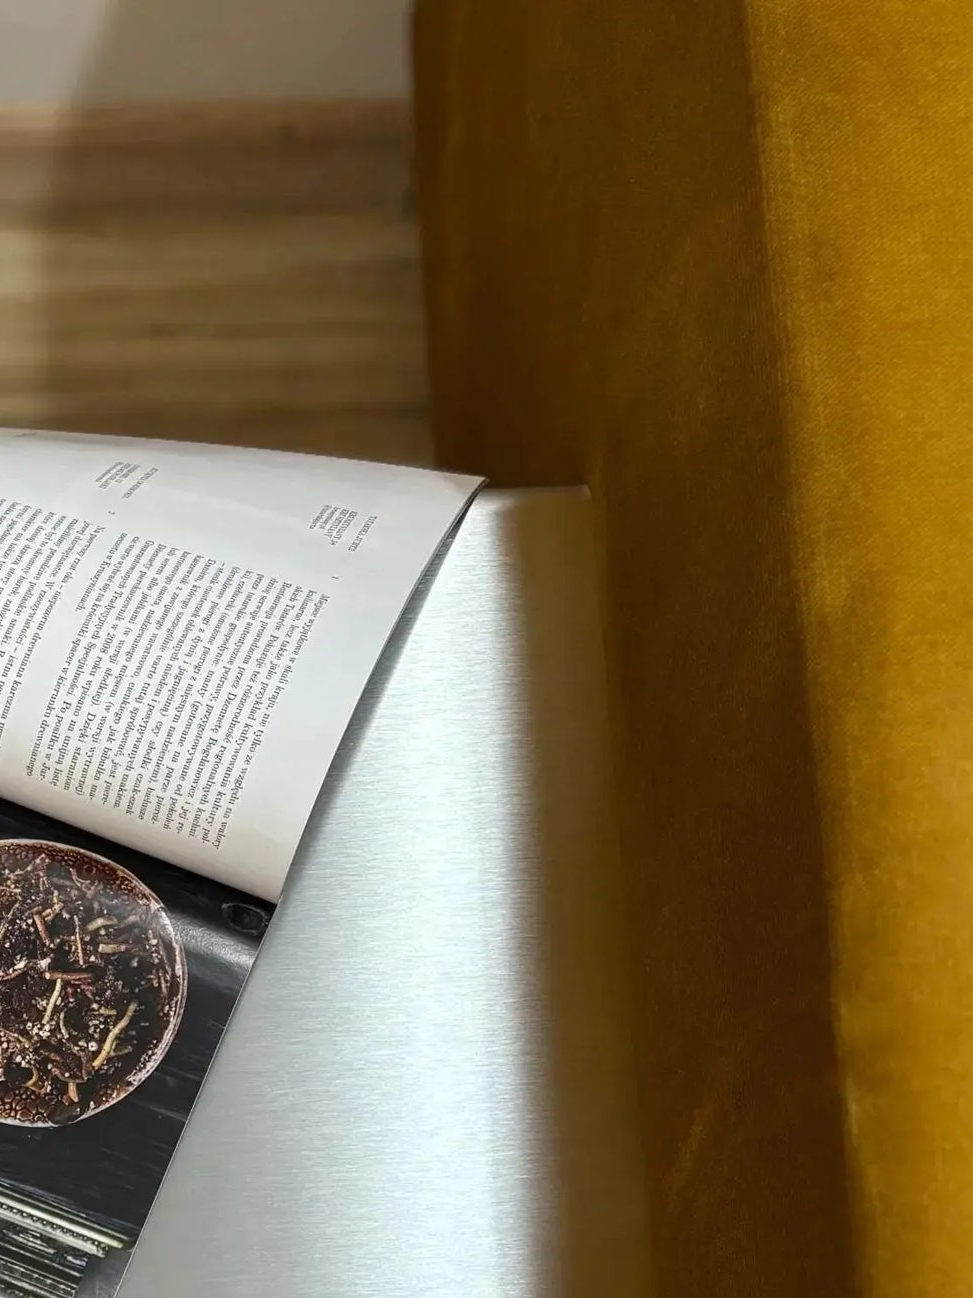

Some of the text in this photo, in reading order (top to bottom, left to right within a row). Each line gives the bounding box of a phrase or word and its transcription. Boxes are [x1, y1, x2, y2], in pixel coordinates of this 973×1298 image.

[0, 618, 18, 645] smaki.
[7, 575, 29, 597] barek,
[14, 581, 37, 616] podlaskie
[15, 589, 47, 646] rzeczywistości
[36, 590, 62, 631] niepozorna
[0, 679, 22, 720] karczma
[1, 654, 18, 678] istna
[15, 631, 43, 678] drewniana
[25, 637, 81, 777] spacer kierunku drewnianego
[67, 632, 117, 732] 2008 roku wpisano na
[91, 609, 156, 745] nadziewanego mięsem wersji
[106, 632, 159, 745] warstwowo, cienkiego jak
[172, 645, 212, 724] pierogi mięsnym
[47, 700, 72, 750] Po posiłku
[63, 638, 125, 791] wersji Dzięki staraniom
[109, 654, 163, 779] warto tutaj spróbować, jest
[125, 663, 173, 773] miodem posypywanych
[141, 720, 164, 771] czy słodki
[161, 669, 215, 793] manty (gotowane na parze
[174, 621, 254, 797] autentyczne potrawy, przygotowywane od
[178, 620, 269, 821] prowadzona przez Dżennetę Bogdanowicz jej
[200, 634, 280, 807] Pokazuje też różnorodność regionalnych
[201, 660, 281, 843] jako przykład kultywowania kultury pol-
[210, 664, 293, 849] skali kraju, nie tylko ze względu na walory
